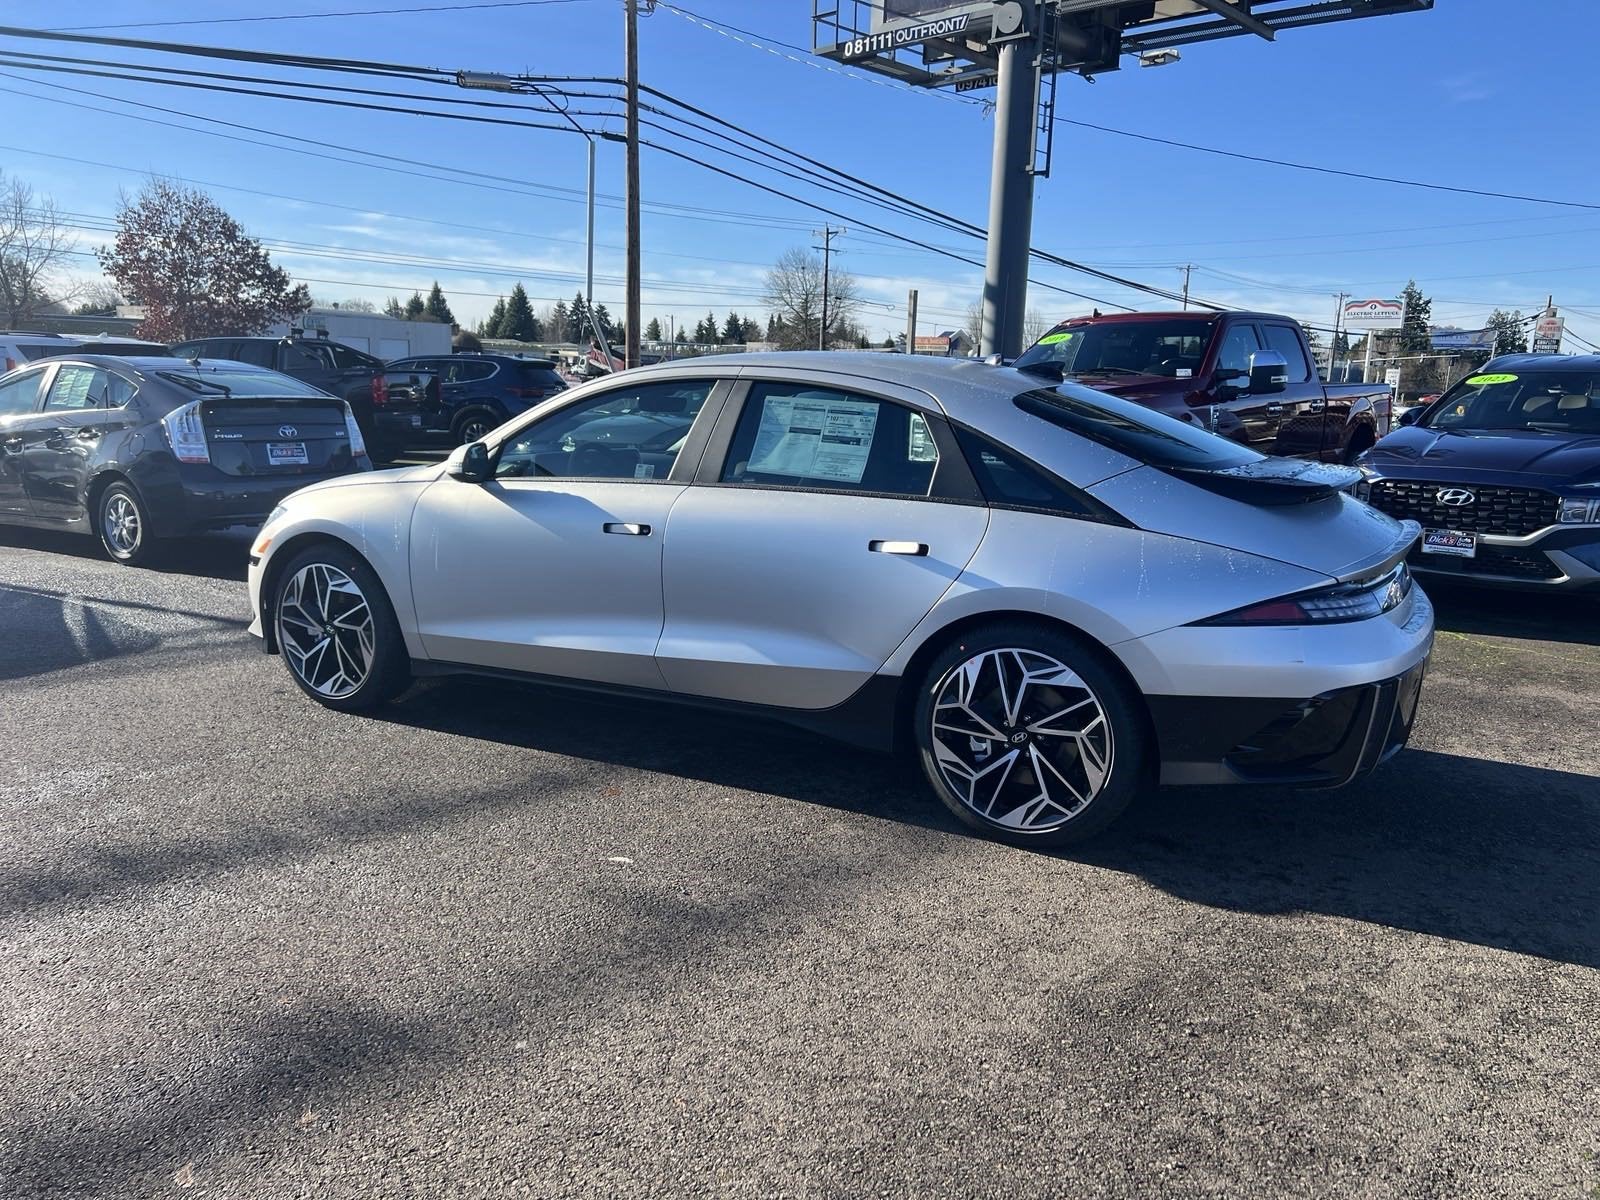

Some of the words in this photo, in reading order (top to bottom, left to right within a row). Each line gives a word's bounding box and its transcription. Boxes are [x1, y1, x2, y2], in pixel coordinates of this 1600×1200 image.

[844, 32, 893, 57] 081111
[1475, 375, 1508, 383] 2023
[1427, 535, 1456, 545] Dick's
